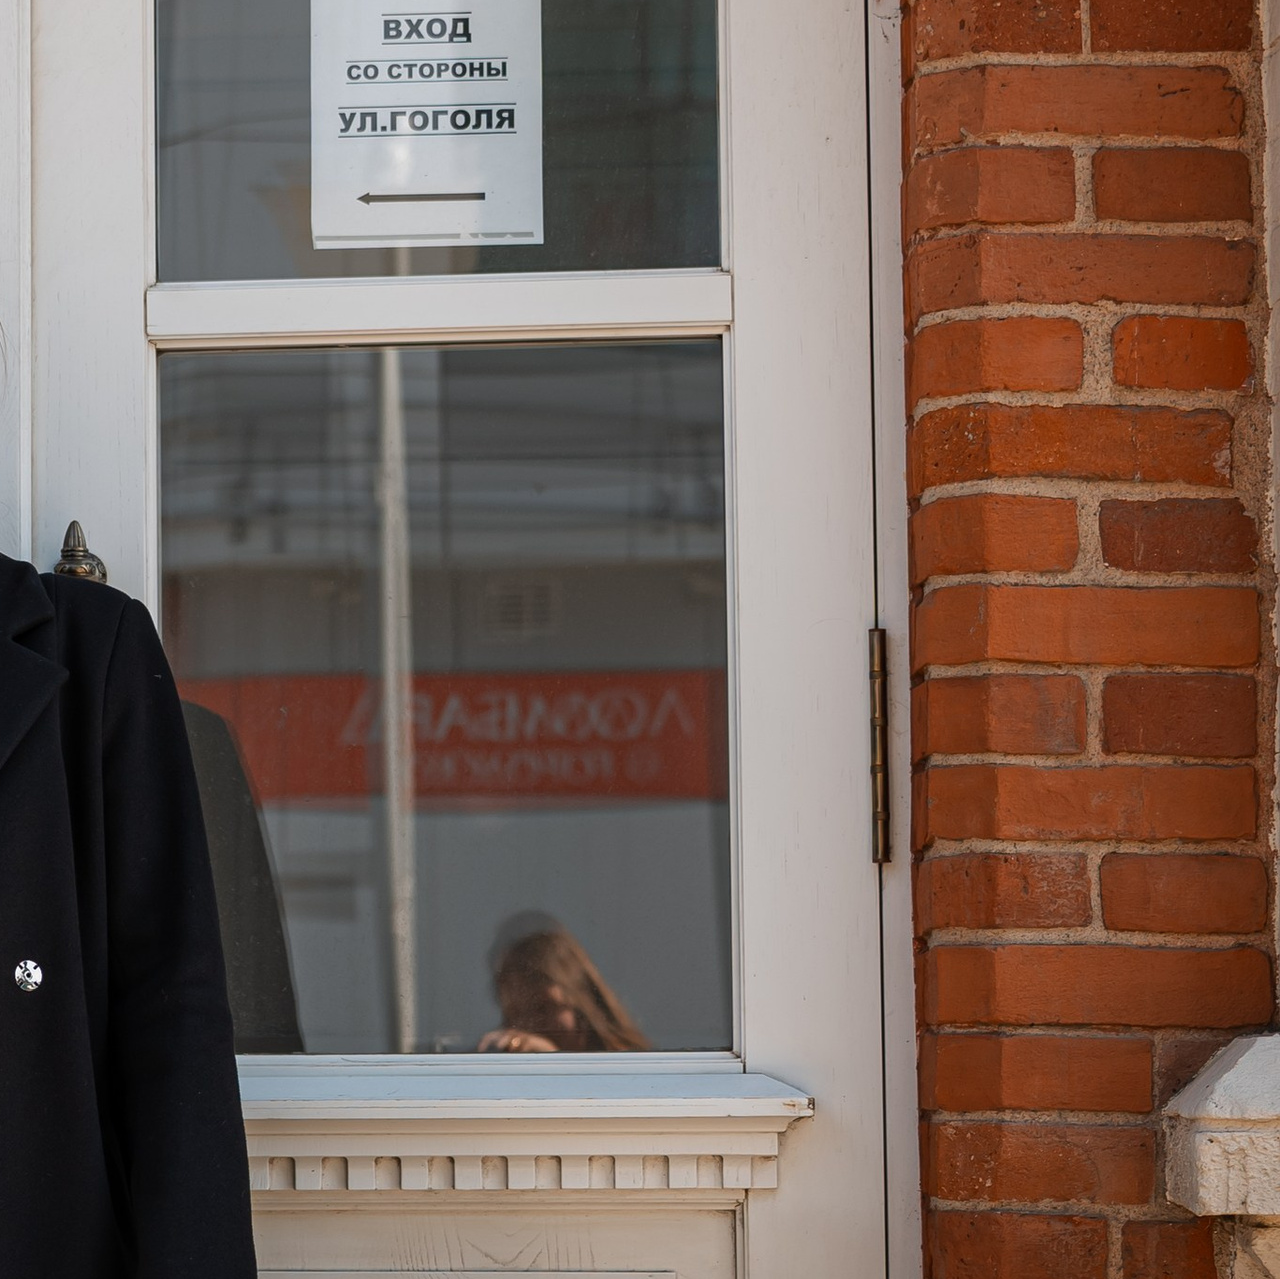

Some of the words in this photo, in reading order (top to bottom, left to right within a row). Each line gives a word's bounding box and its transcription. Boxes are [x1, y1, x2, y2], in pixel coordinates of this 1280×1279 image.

[383, 18, 472, 43] ВХОД
[347, 63, 379, 80] СО
[387, 61, 507, 79] СТОРОНЫ
[338, 108, 516, 133] УЛ.ГОГОЛЯ
